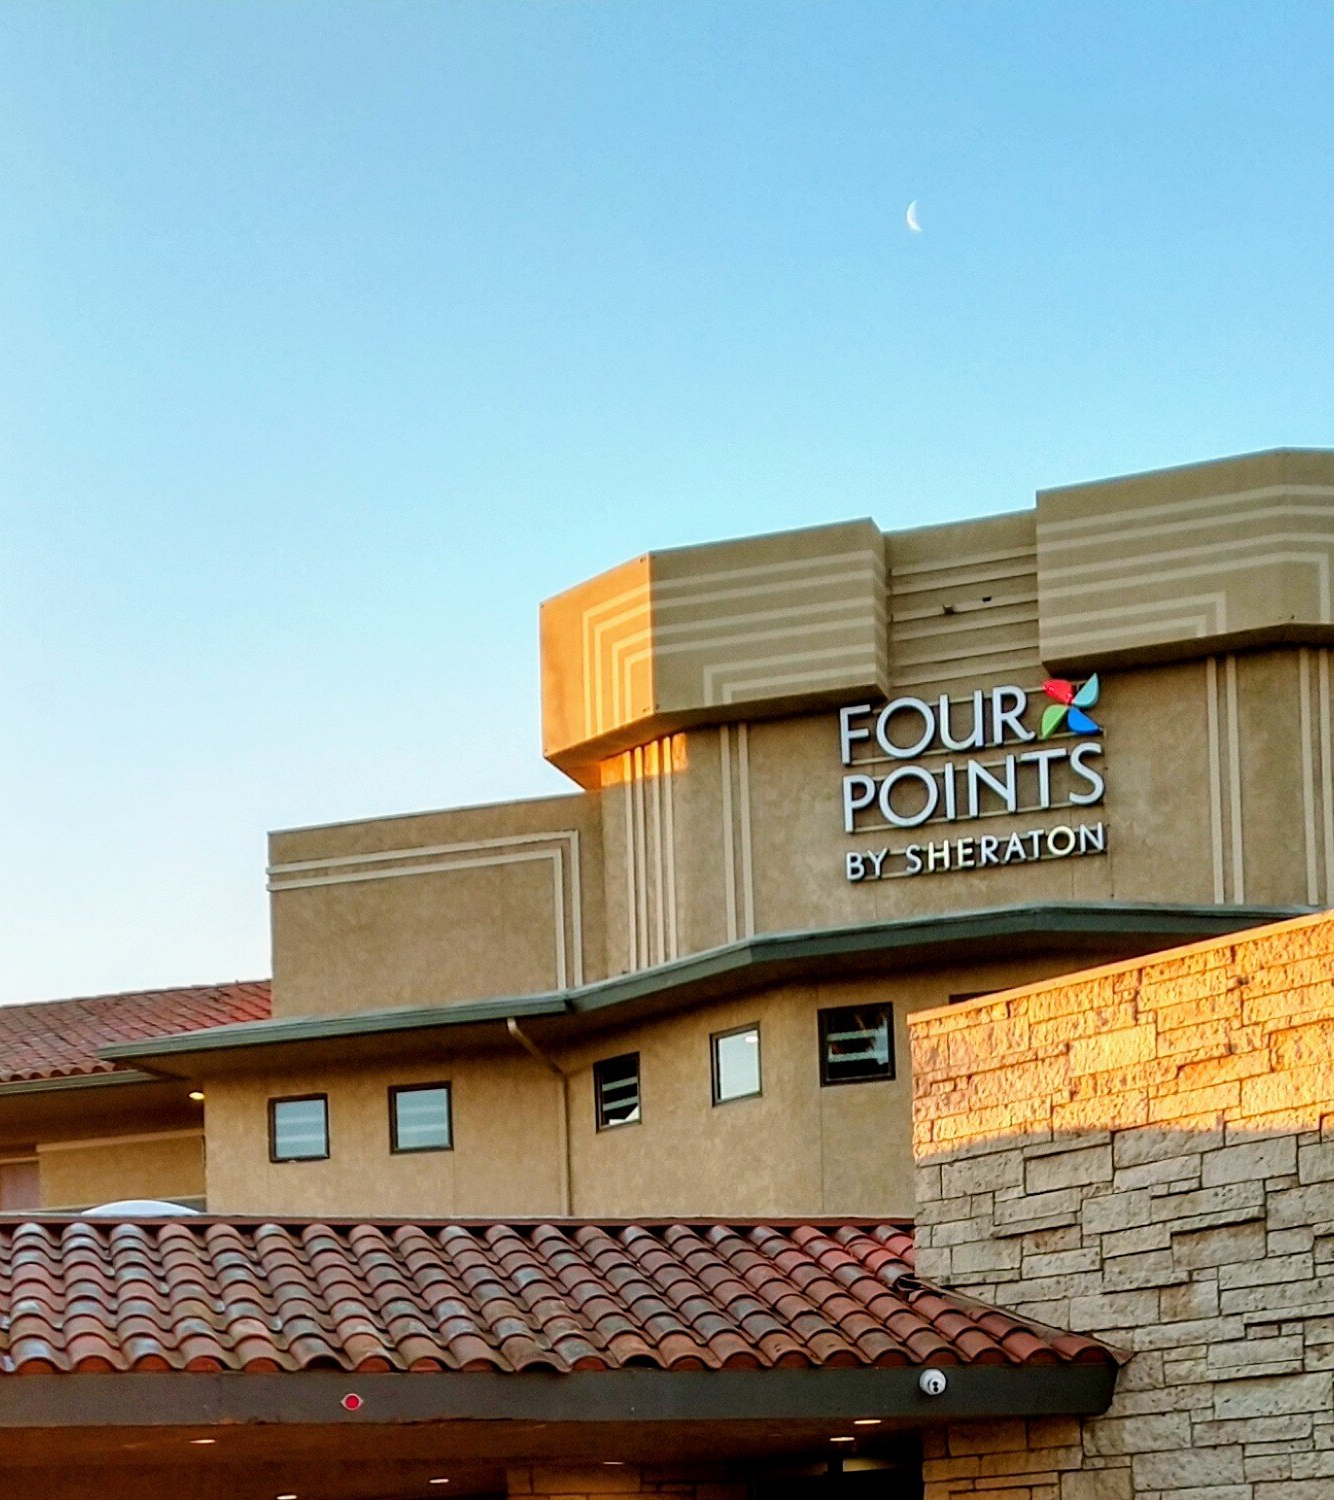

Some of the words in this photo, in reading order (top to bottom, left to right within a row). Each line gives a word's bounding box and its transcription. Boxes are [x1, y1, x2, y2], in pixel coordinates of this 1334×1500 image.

[839, 685, 1036, 766] FOUR
[842, 742, 1105, 833] POINTS
[845, 848, 888, 882] BY
[905, 822, 1105, 874] SHERATON
